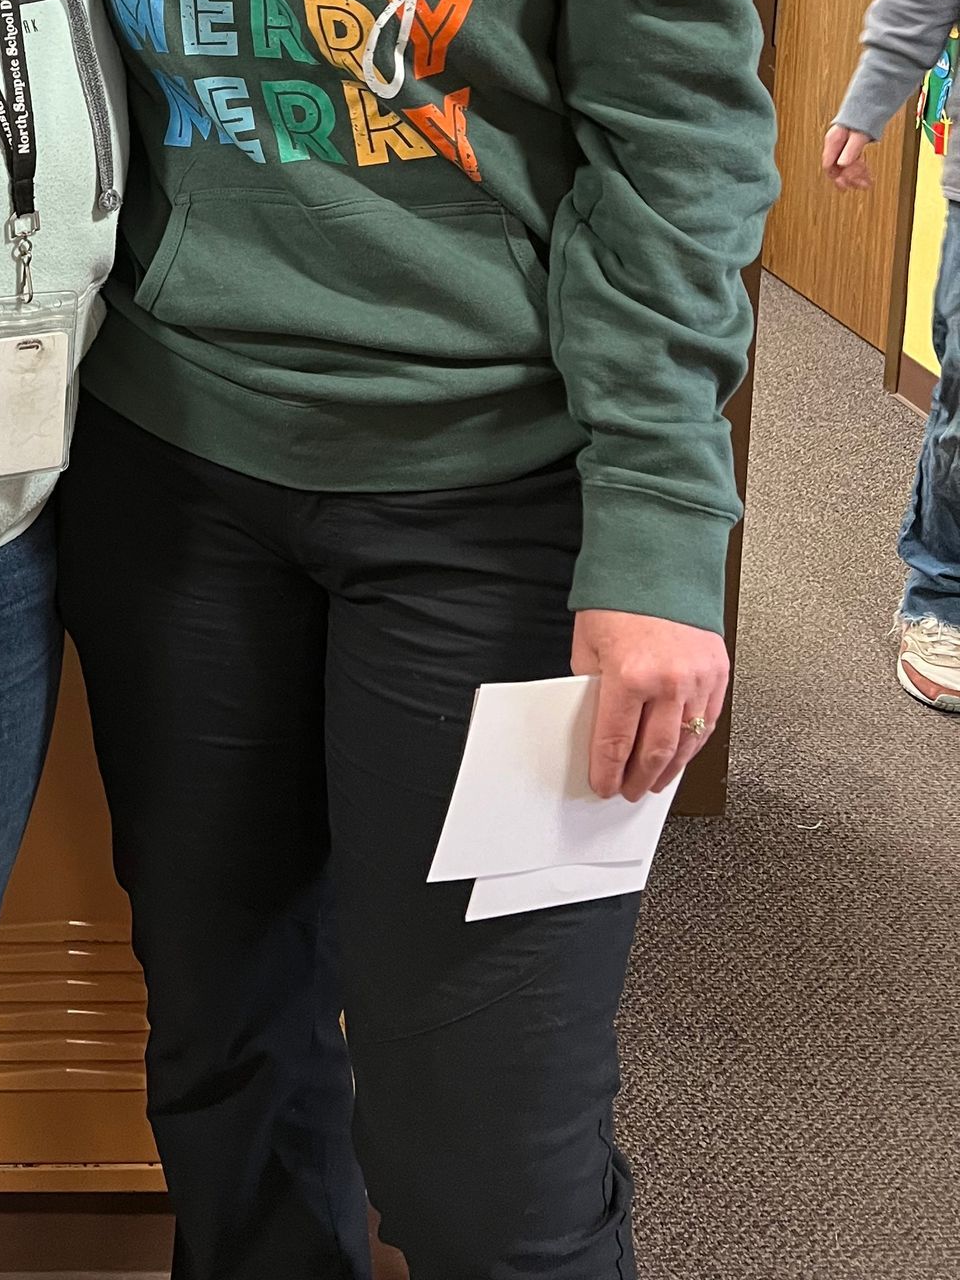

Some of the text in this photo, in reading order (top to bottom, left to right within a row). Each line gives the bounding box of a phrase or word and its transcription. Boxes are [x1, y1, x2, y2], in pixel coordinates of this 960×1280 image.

[1, 10, 19, 57] School
[10, 58, 26, 112] Sanpete
[15, 109, 30, 154] North
